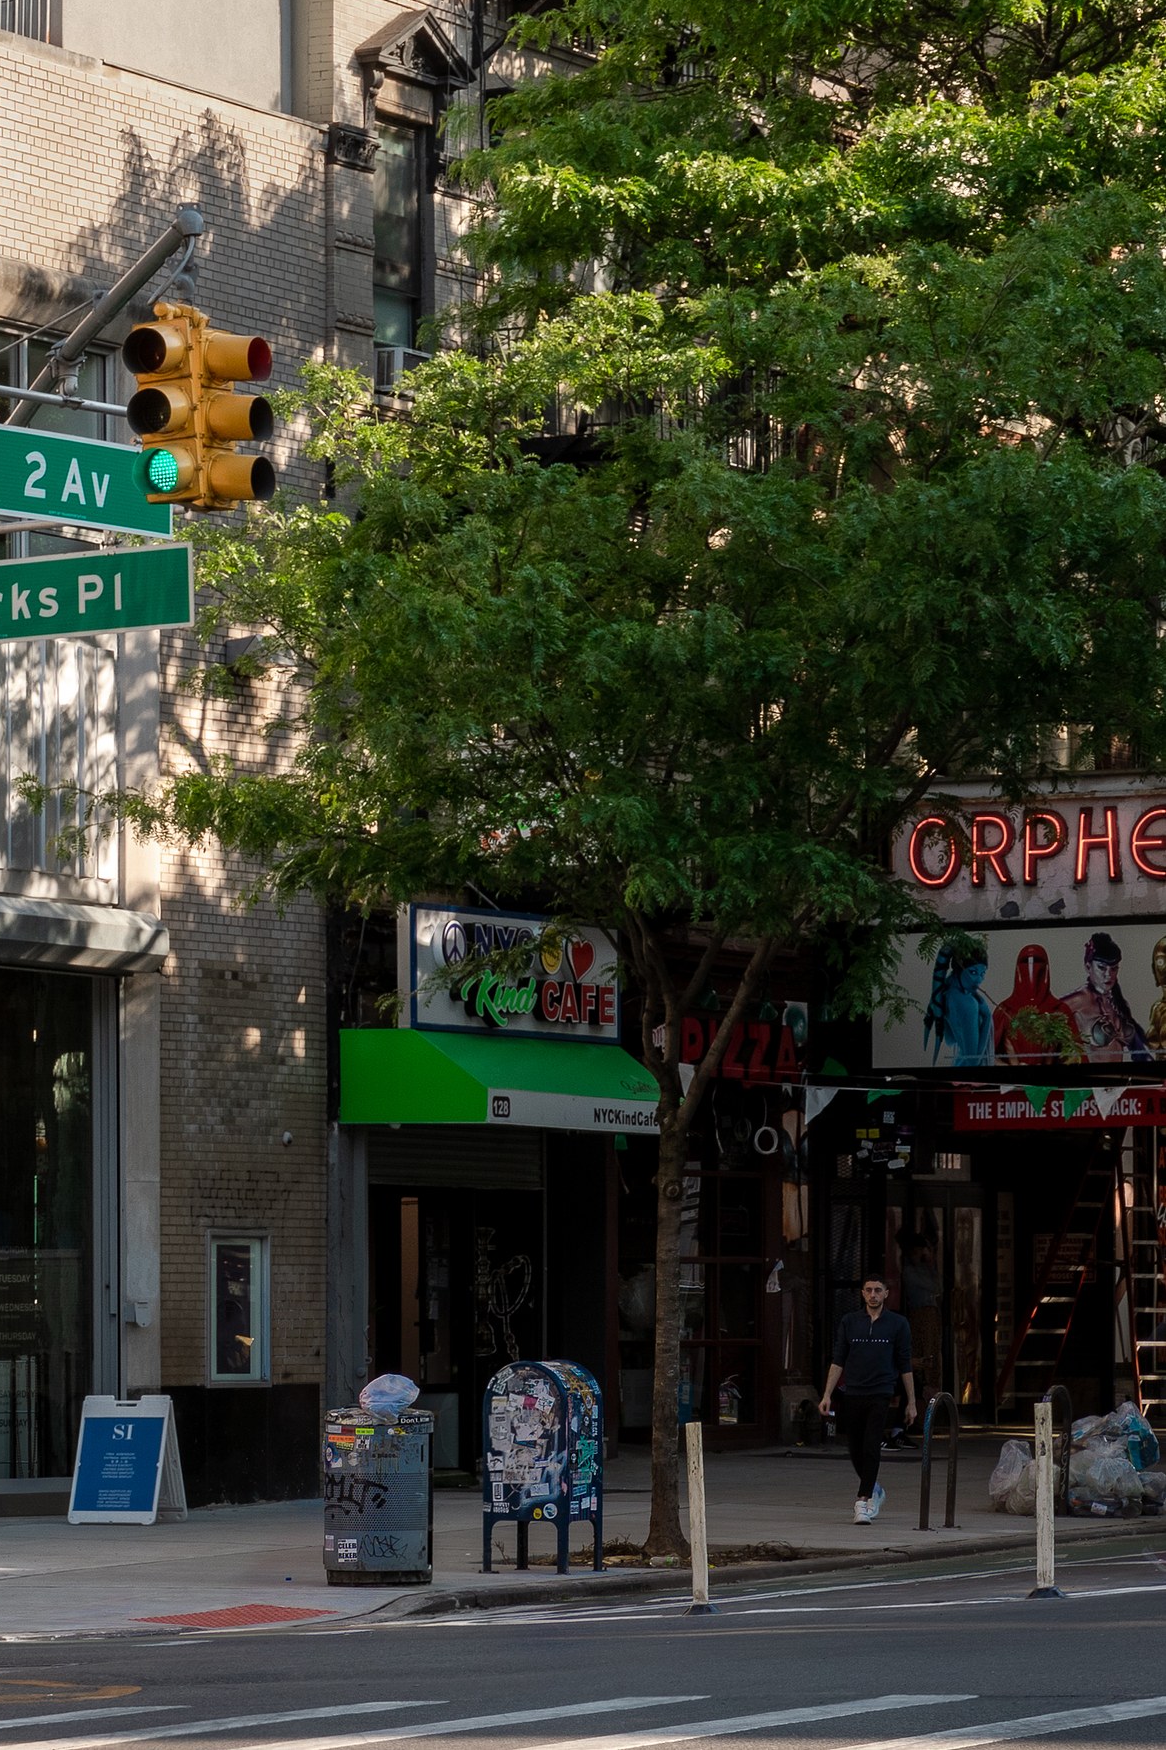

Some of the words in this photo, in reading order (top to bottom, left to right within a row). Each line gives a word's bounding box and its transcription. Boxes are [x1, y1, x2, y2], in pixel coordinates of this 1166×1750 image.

[24, 451, 47, 499] 2
[61, 458, 110, 507] Av
[78, 572, 122, 614] Pl
[460, 969, 538, 1027] Kind
[541, 980, 616, 1026] CAFE
[493, 1099, 510, 1118] 128
[967, 1102, 993, 1119] THE
[112, 1424, 134, 1440] SI
